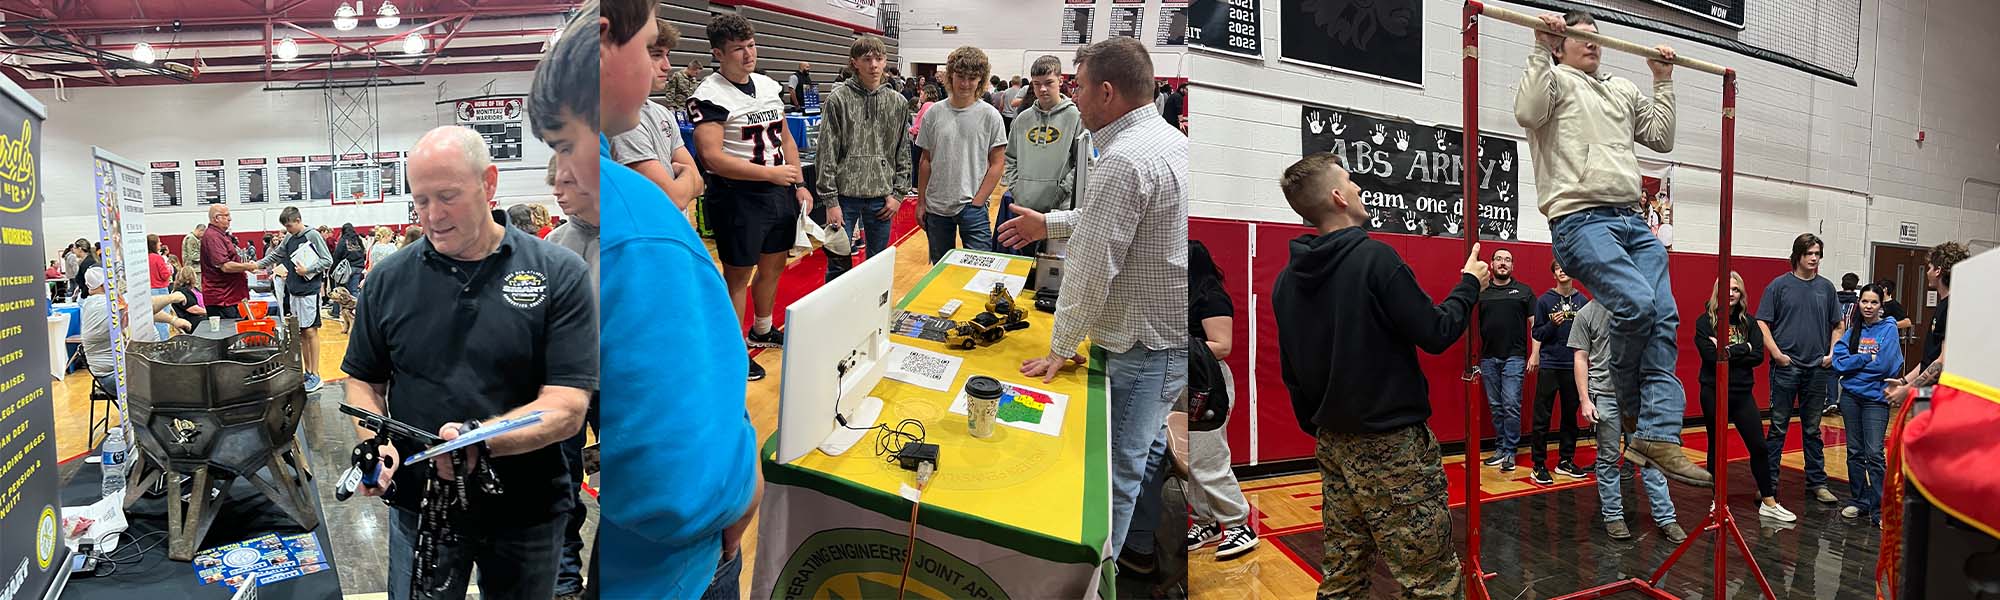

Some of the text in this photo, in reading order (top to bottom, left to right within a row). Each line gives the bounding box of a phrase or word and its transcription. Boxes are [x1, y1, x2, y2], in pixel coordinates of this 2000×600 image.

[1229, 8, 1254, 22] 2021
[1711, 5, 1728, 19] WON
[1228, 22, 1255, 36] 2022
[1229, 35, 1256, 49] 2022
[747, 109, 779, 124] MONITEAU
[742, 120, 784, 165] 75
[1361, 190, 1515, 222] eam. one deam.
[2, 227, 33, 246] WORKERS
[0, 373, 25, 392] RAISES
[16, 387, 44, 409] CREDITS
[13, 420, 29, 439] DEBT
[24, 433, 46, 454] WAGES
[8, 465, 35, 497] PENSION
[828, 543, 911, 565] ENGINEERS
[914, 554, 967, 588] JOINT
